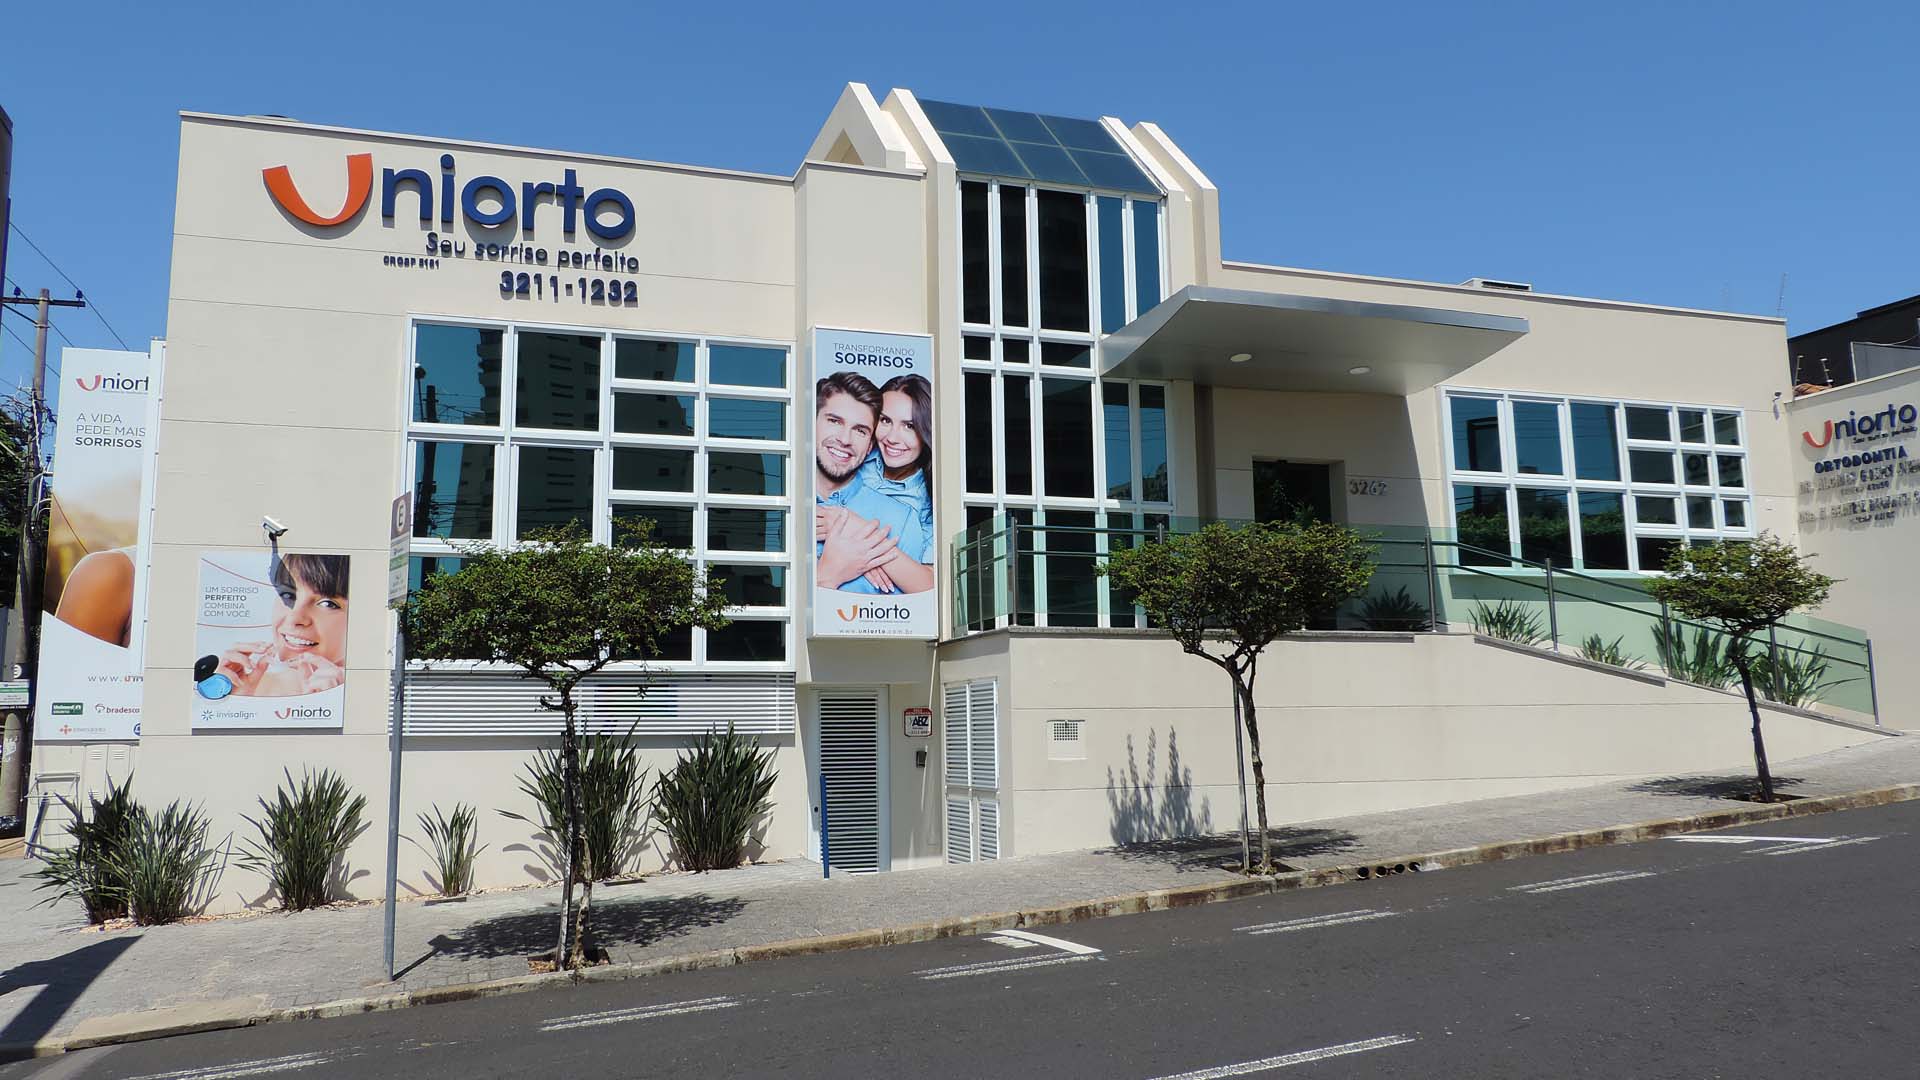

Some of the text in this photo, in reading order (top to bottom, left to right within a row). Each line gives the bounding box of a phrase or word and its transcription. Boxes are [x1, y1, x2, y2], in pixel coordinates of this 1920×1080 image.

[262, 153, 635, 239] Uniorto
[425, 232, 640, 272] Seu sorriso perfeito
[499, 271, 639, 304] 3211-1232
[833, 343, 914, 356] TRANSFORMANDO
[835, 352, 914, 369] SORRISOS
[77, 412, 122, 424] A VIDA
[76, 425, 146, 437] PEDE MAIS
[1802, 404, 1918, 448] Uniorto
[75, 436, 142, 449] SORRISOS
[1814, 445, 1908, 474] ORTODONTIA
[205, 586, 259, 594] UM SORRISO
[205, 594, 247, 602] PERFEITO
[204, 602, 245, 610] COMBINA
[837, 602, 910, 622] Uniorto
[216, 711, 254, 720] invisalign
[274, 705, 332, 720] Uniorto
